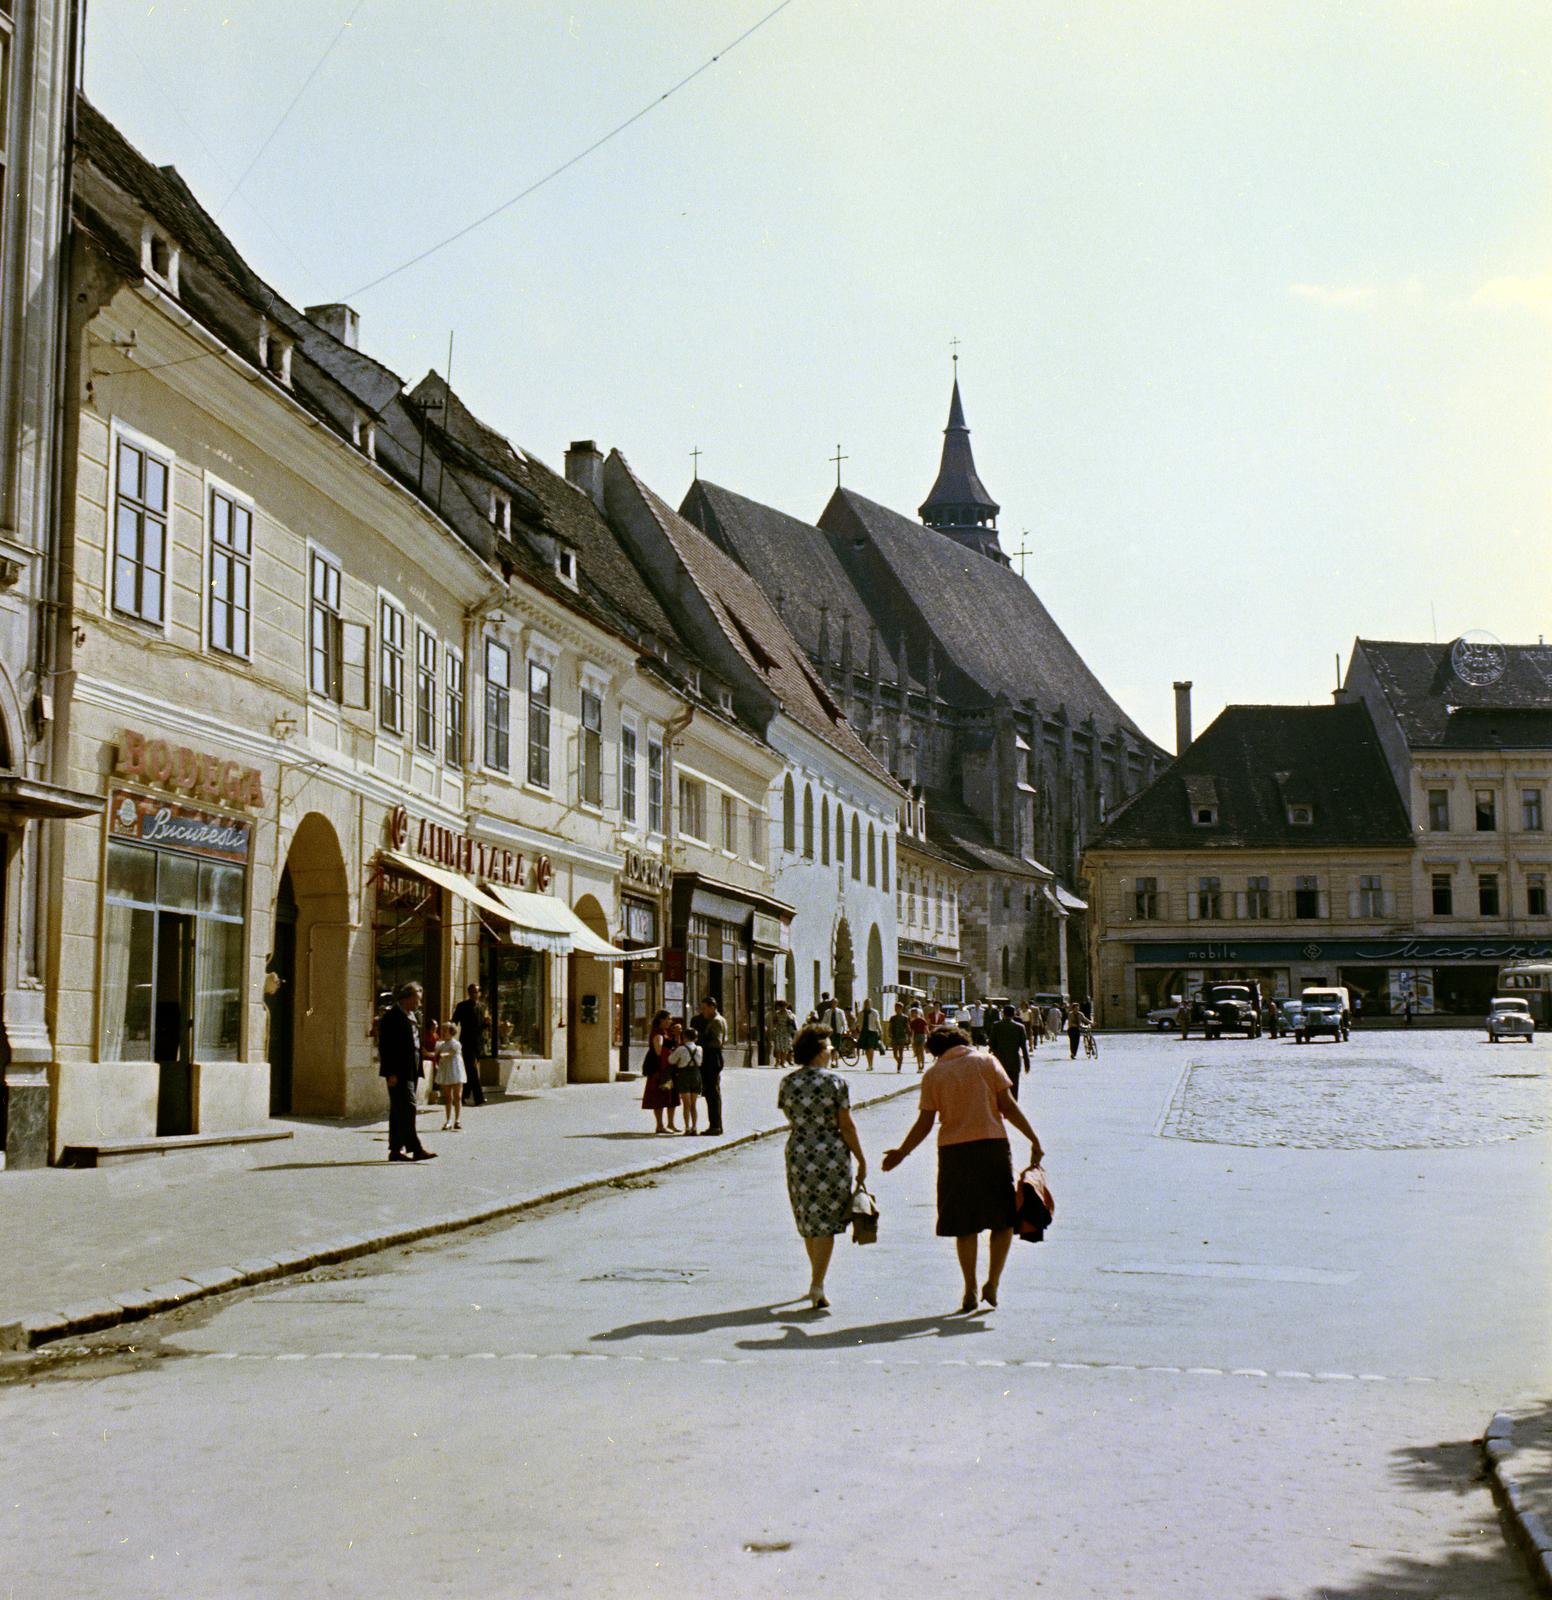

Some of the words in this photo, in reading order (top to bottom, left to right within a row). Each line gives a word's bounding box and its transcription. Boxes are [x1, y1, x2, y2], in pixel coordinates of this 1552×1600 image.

[123, 729, 265, 808] BODEGA
[417, 818, 526, 887] ALIMENTARA
[1188, 943, 1237, 959] mobile
[1400, 971, 1408, 983] P
